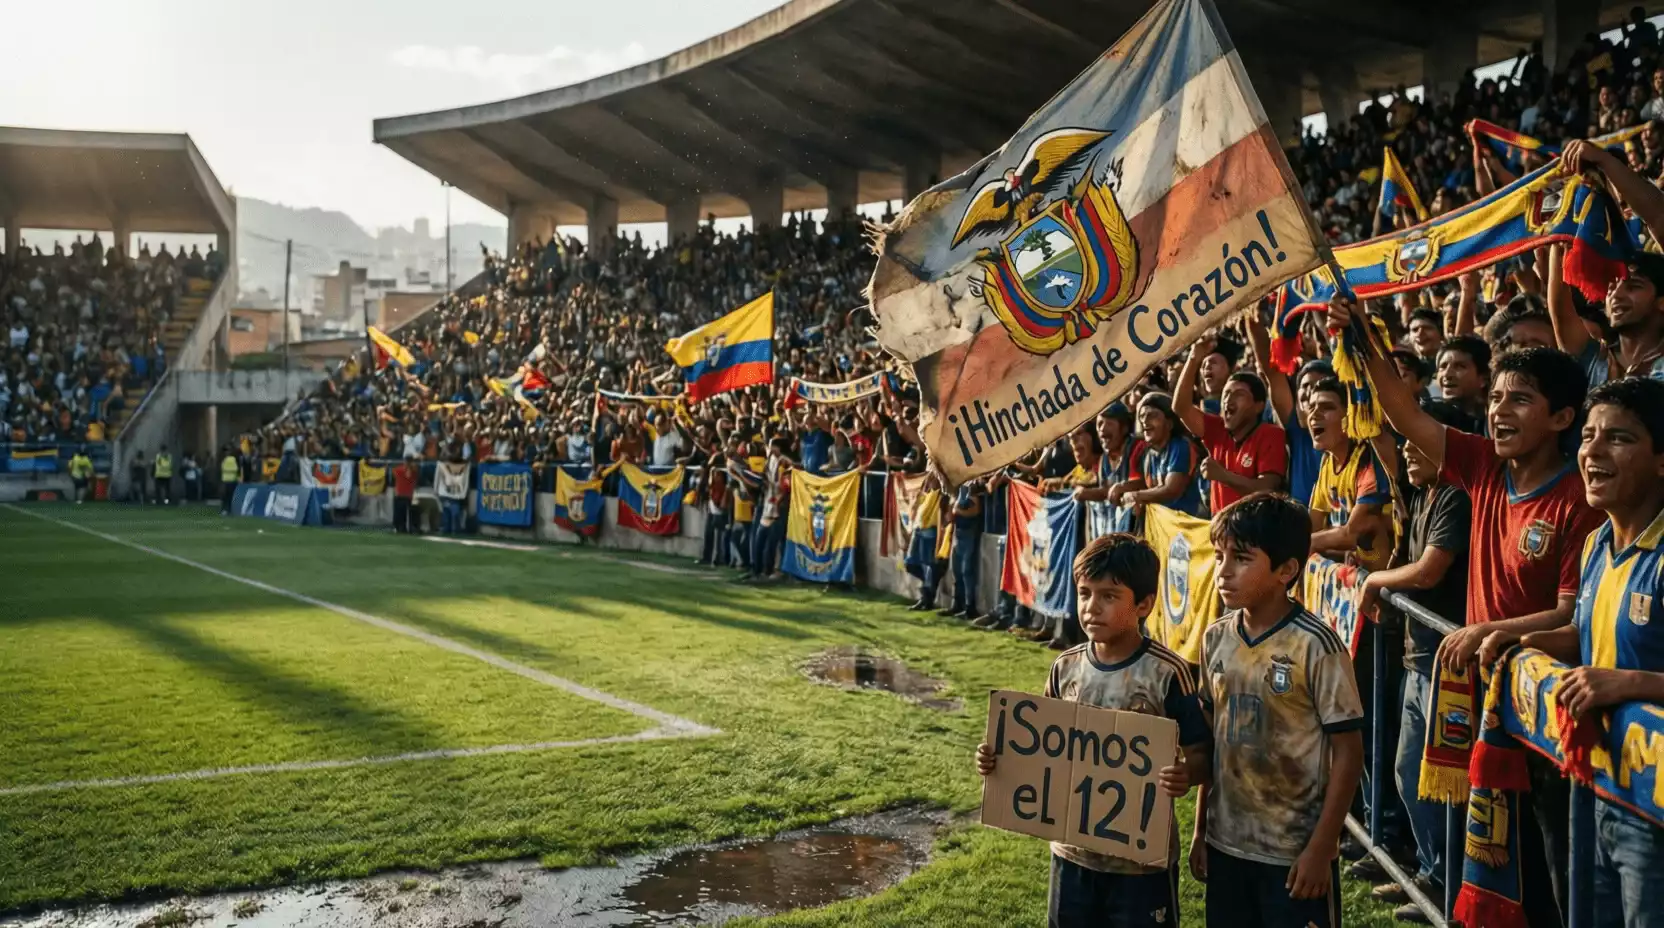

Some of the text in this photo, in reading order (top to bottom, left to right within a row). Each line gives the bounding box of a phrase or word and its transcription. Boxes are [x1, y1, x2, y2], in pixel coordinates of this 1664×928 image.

[949, 210, 1287, 466] ¡Hinchada de Corazón!
[995, 697, 1152, 777] ¡Somos
[1074, 775, 1156, 850] 12!
